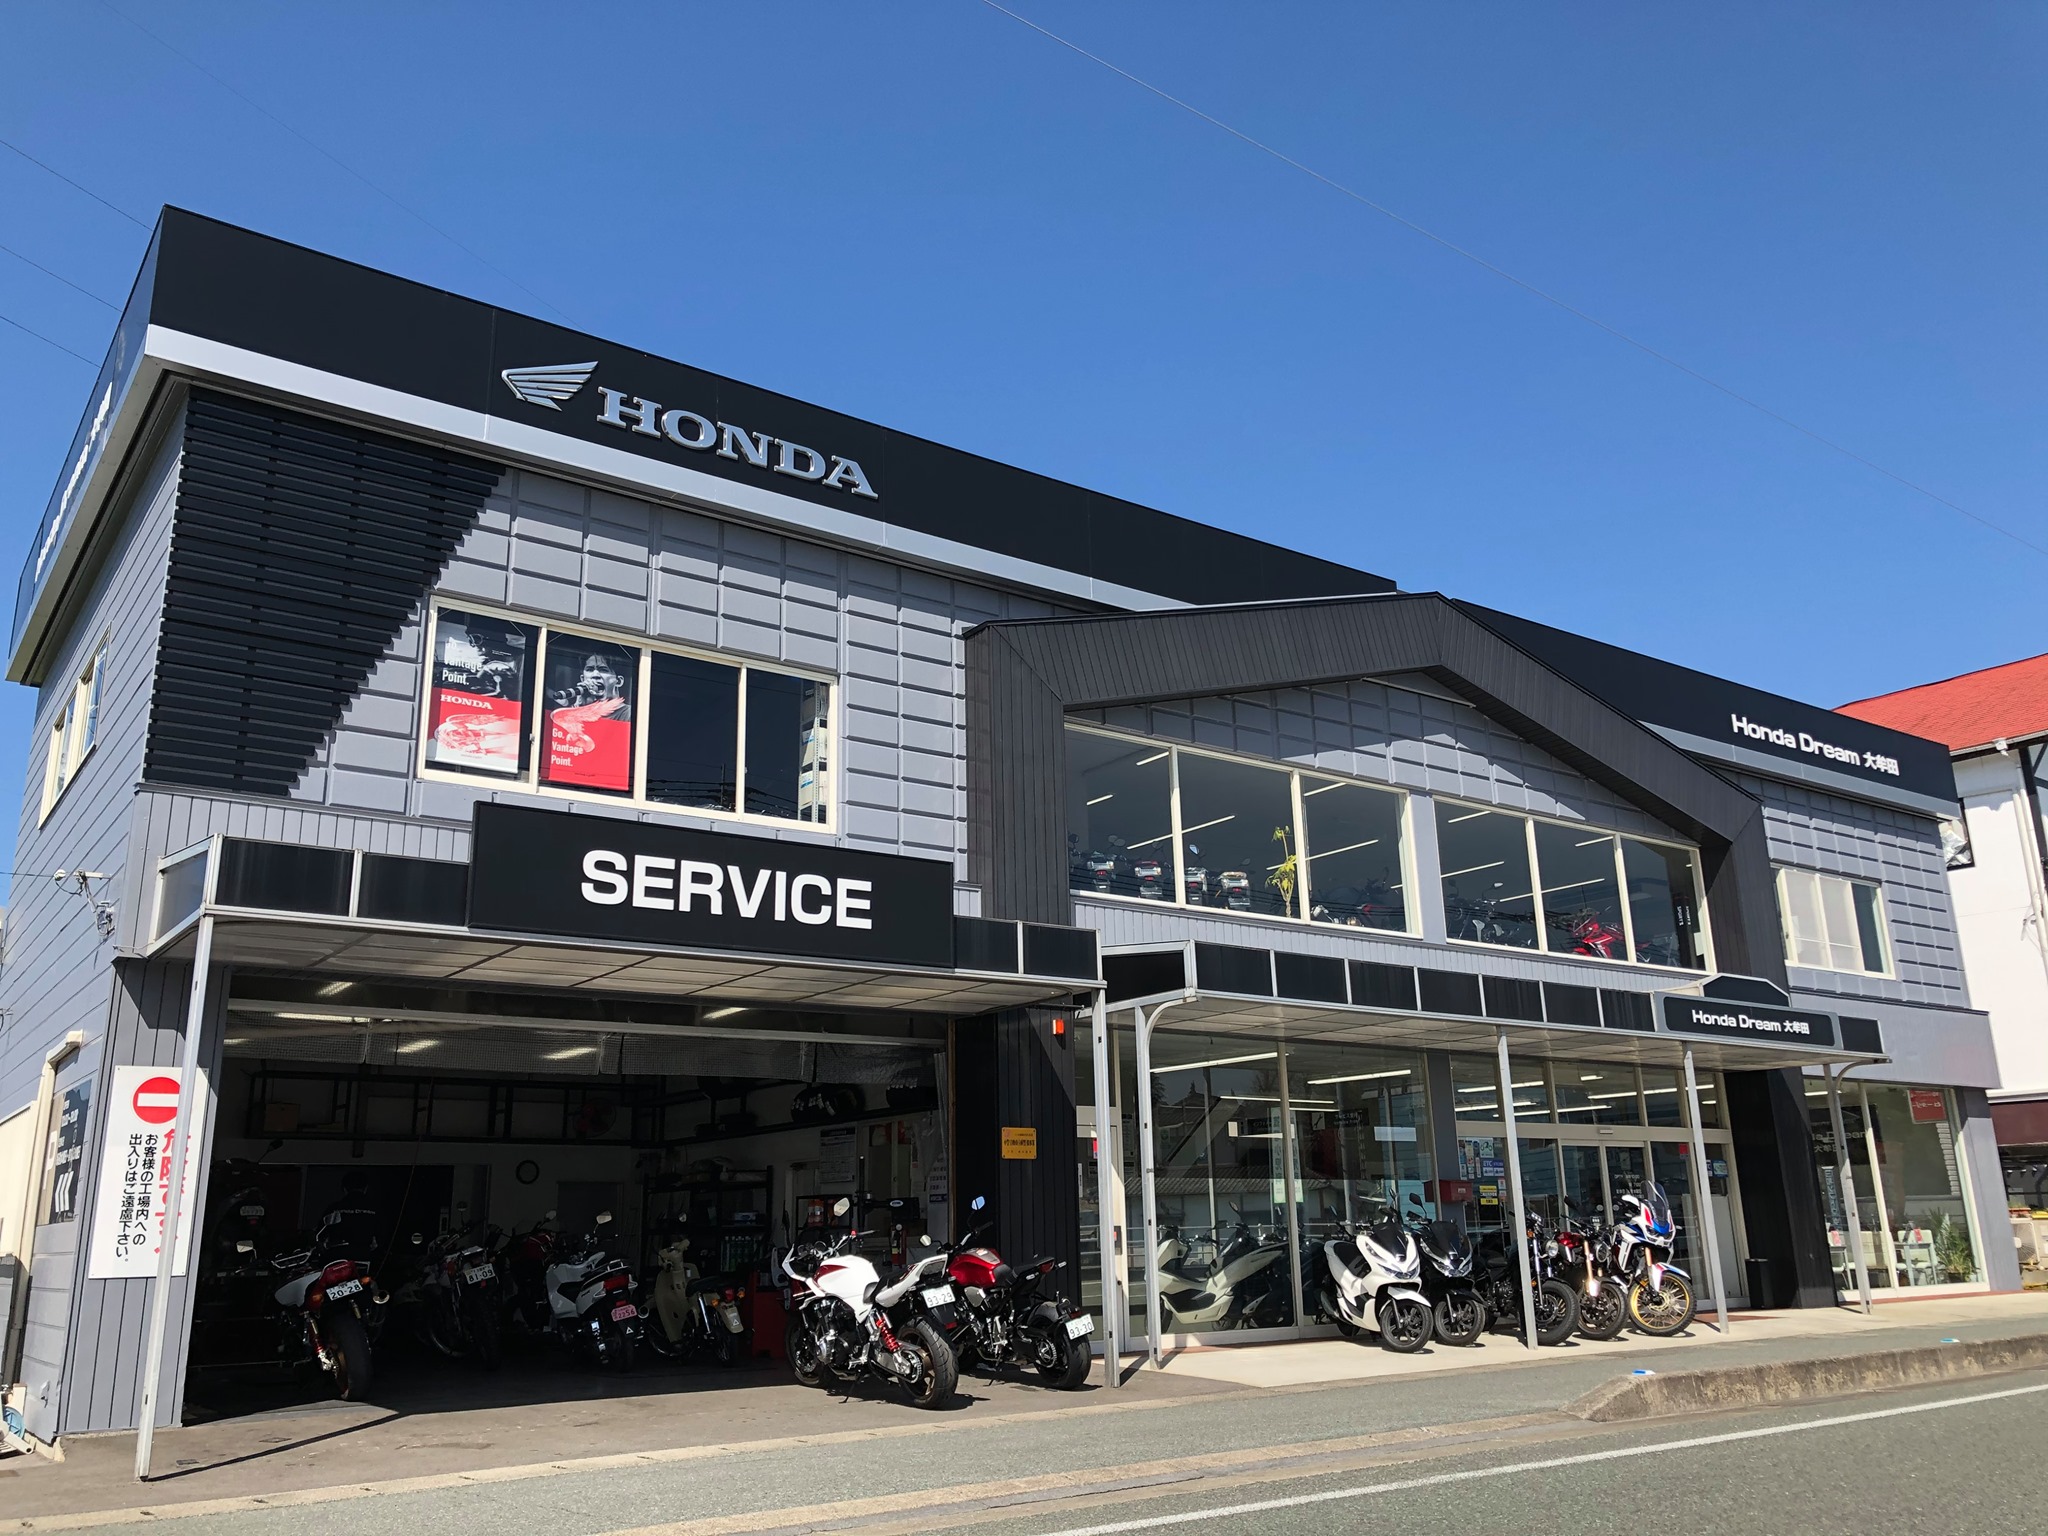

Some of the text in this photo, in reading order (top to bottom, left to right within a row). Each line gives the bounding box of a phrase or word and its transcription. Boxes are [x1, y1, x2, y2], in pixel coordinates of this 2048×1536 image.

[597, 386, 879, 500] HONDA
[442, 668, 469, 686] Point.
[440, 694, 493, 710] HONDA
[552, 727, 565, 740] Go.
[552, 741, 584, 756] Vantage
[1731, 714, 1900, 776] Honda Dream 大牟田
[551, 755, 573, 767] Point.
[581, 850, 872, 930] SERVICE
[1692, 1010, 1810, 1035] Honda Dream 大牟田
[132, 1133, 159, 1246] お客様の工場内への
[469, 1269, 493, 1282] 81-09
[330, 1284, 361, 1299] 20-28
[927, 1292, 953, 1306] 93-29
[618, 1308, 635, 1319] 2256
[1069, 1322, 1093, 1338] 93-30
